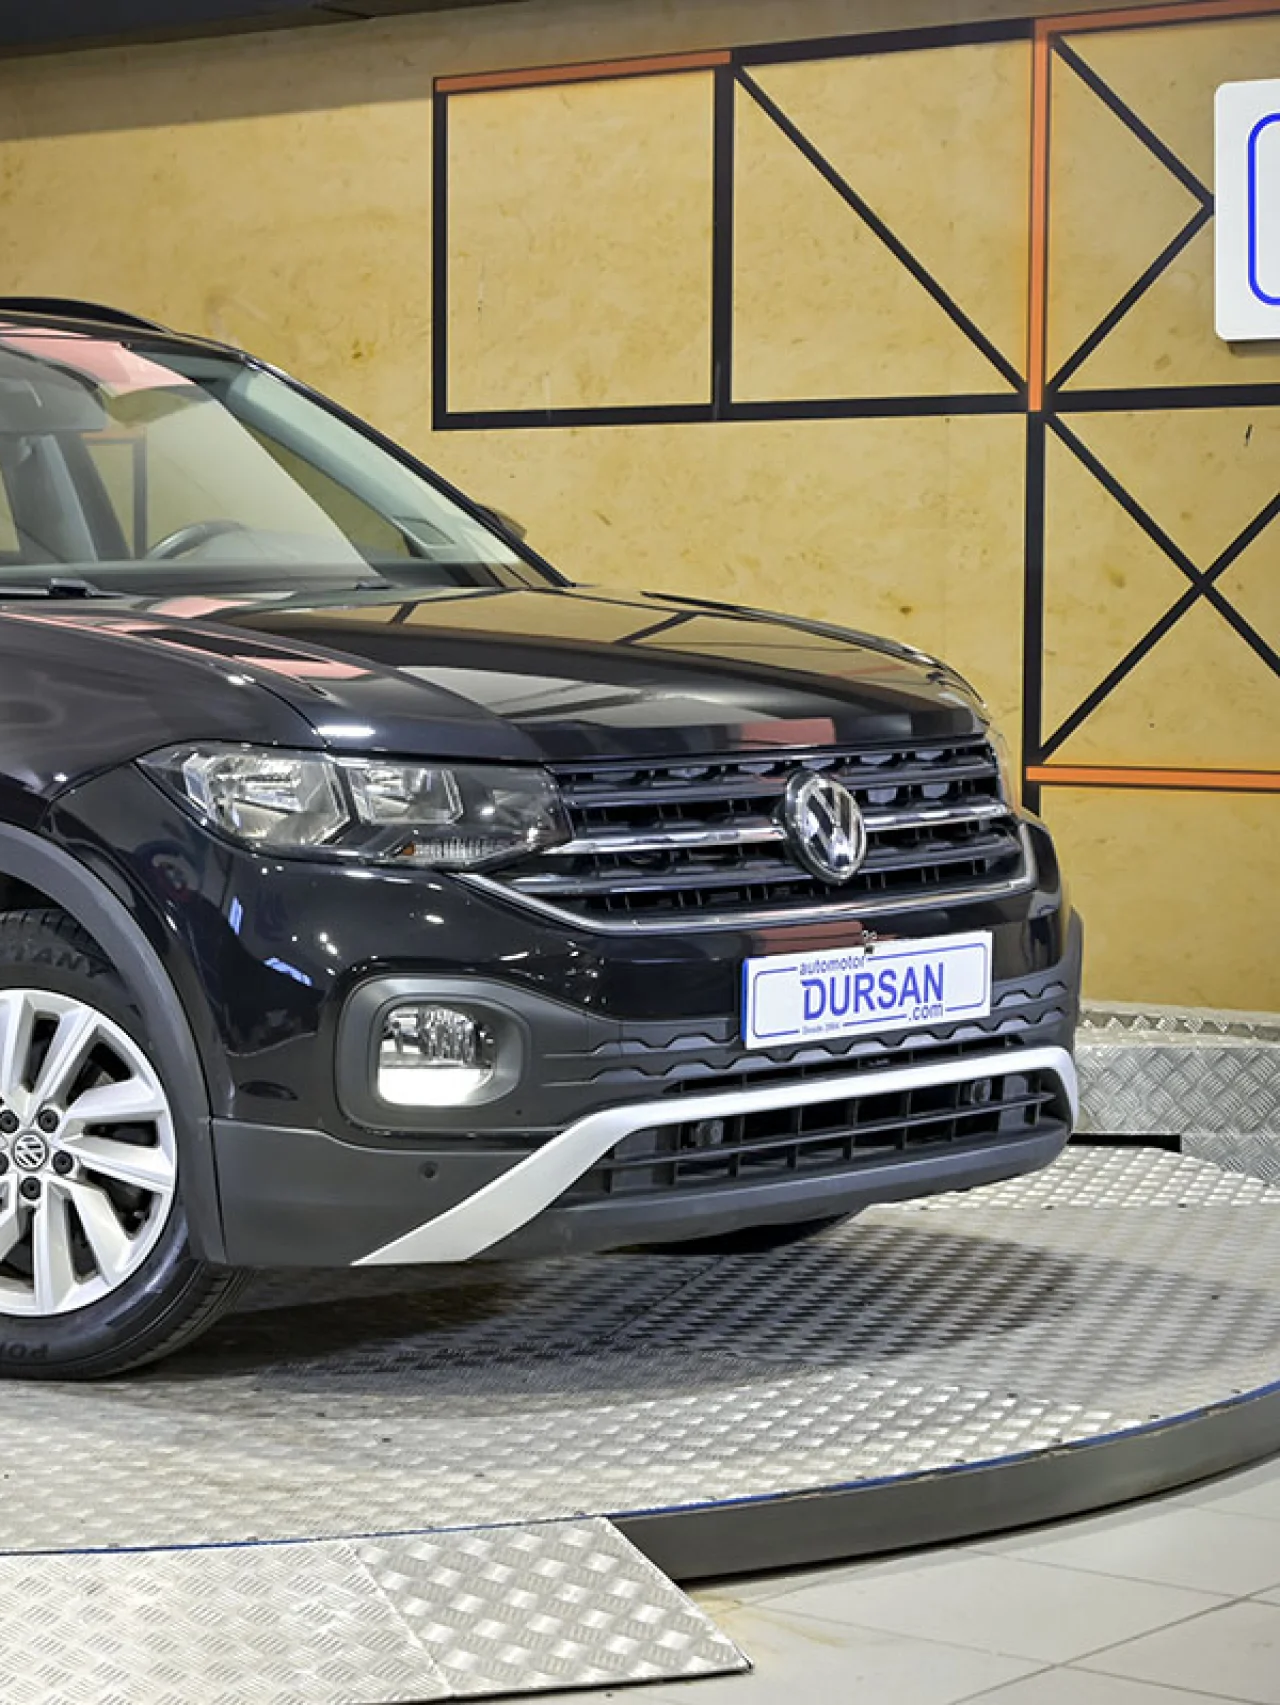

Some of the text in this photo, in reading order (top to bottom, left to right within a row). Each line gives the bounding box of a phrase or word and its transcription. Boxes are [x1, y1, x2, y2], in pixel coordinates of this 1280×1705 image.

[799, 954, 865, 976] automotor
[800, 962, 944, 1021] DURSAN
[908, 1002, 944, 1021] .com
